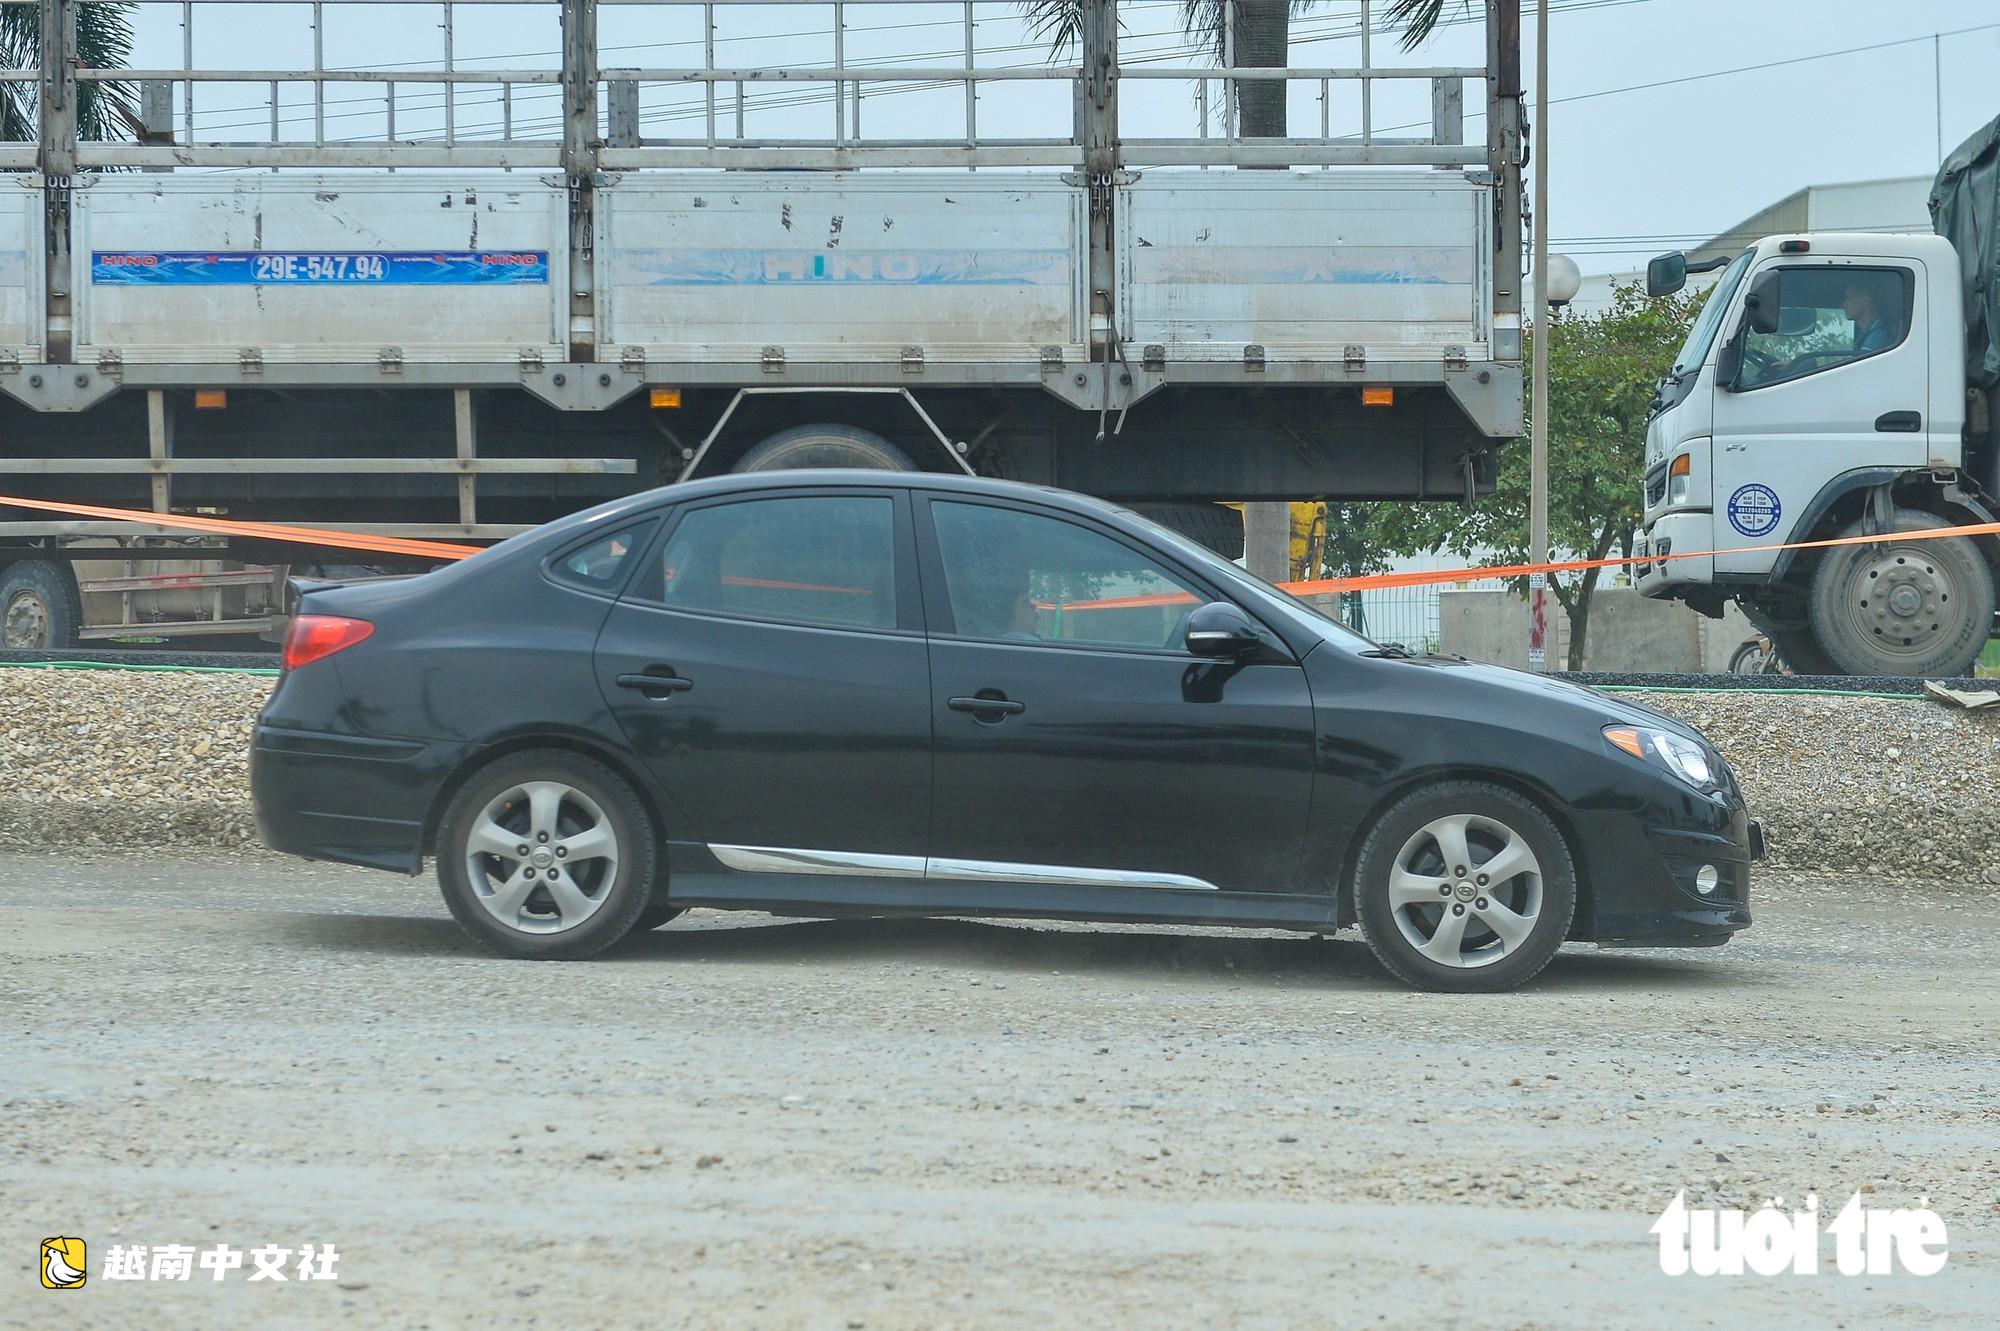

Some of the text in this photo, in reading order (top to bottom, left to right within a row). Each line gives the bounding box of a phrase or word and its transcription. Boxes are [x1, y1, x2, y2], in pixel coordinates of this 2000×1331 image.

[101, 255, 158, 267] HINO
[256, 255, 384, 280] 29E-547.94
[482, 254, 538, 266] HINO
[765, 254, 921, 281] HINO
